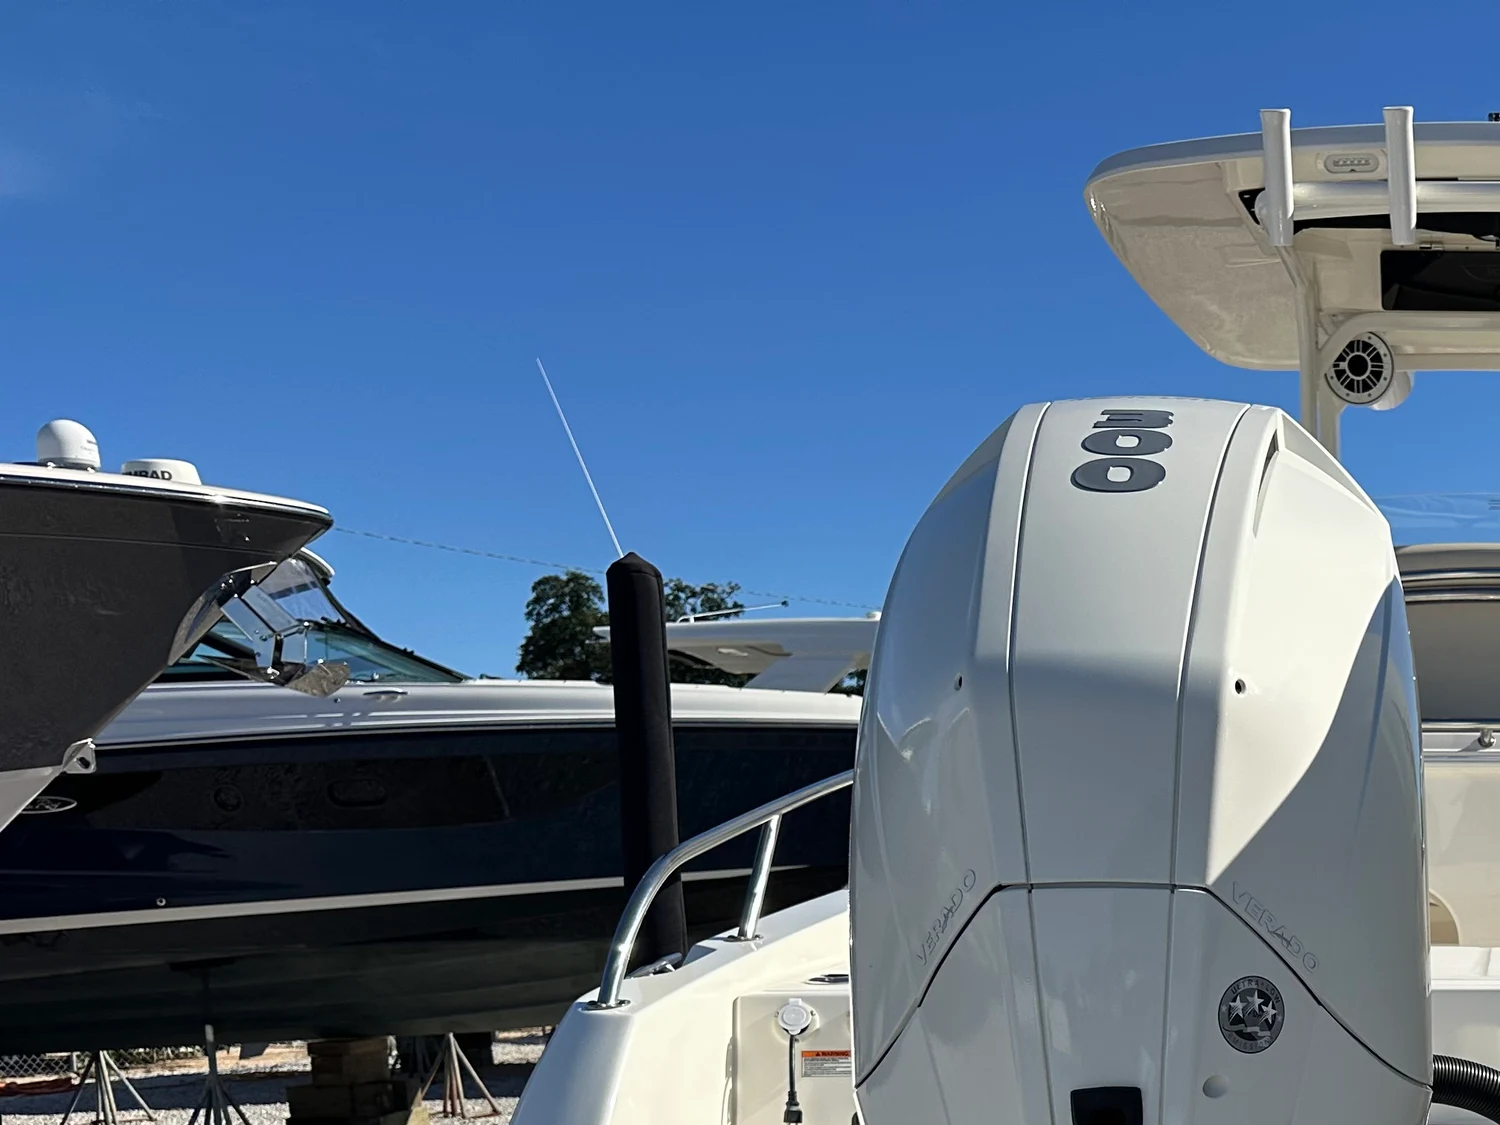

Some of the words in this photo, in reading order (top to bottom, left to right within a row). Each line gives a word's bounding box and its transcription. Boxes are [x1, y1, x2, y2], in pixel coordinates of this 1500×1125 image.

[1069, 409, 1174, 493] 300
[916, 868, 976, 966] VERADO
[1232, 881, 1320, 974] VERADO
